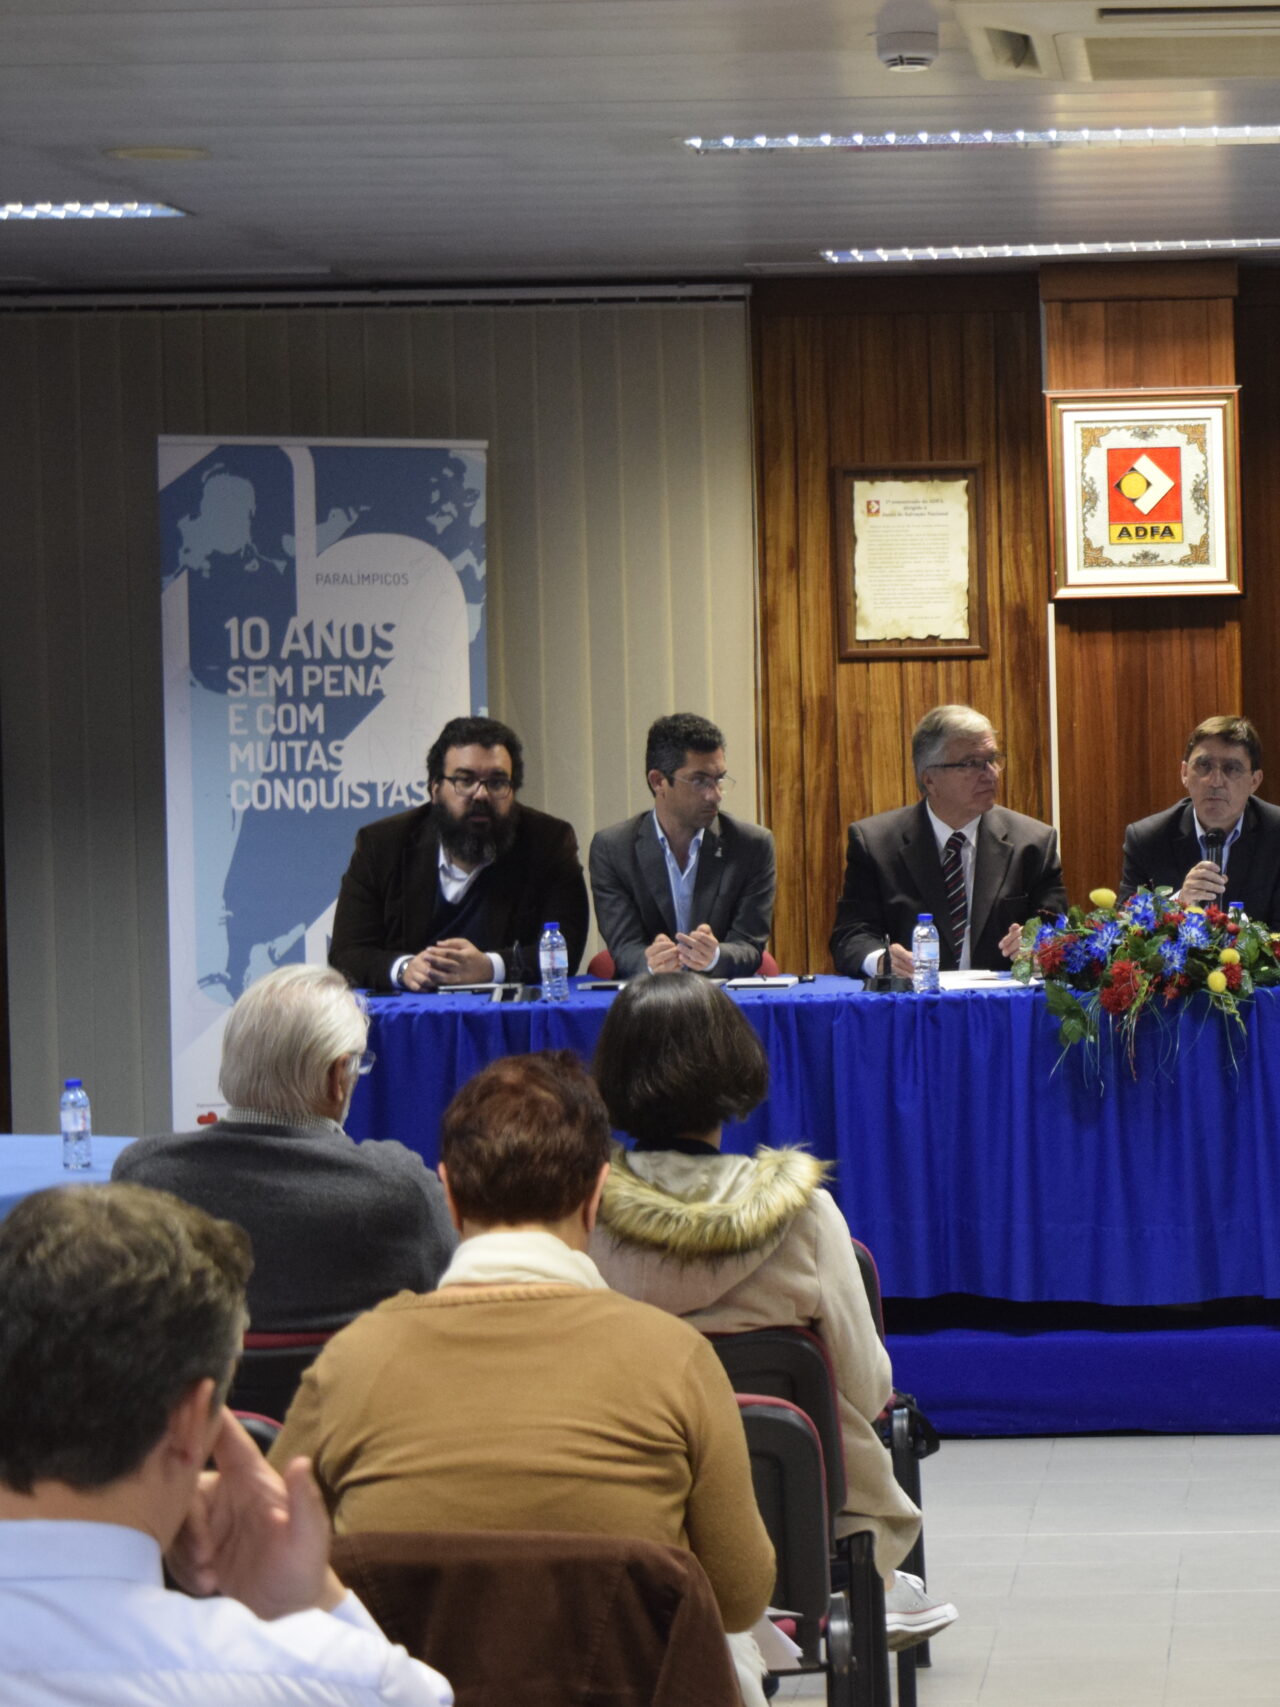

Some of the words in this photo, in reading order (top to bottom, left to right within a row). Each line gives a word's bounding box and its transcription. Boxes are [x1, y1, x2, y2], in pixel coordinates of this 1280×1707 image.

[1117, 525, 1175, 539] ADFA
[316, 568, 409, 586] PARALÍMPICOS
[224, 616, 270, 660] 10
[280, 615, 397, 660] ANOS
[227, 664, 294, 697] SEM
[302, 664, 387, 697] PENA
[228, 703, 248, 735] E
[256, 703, 325, 735] COM
[229, 740, 345, 773] MUITAS
[230, 778, 431, 813] CONQUISTAS
